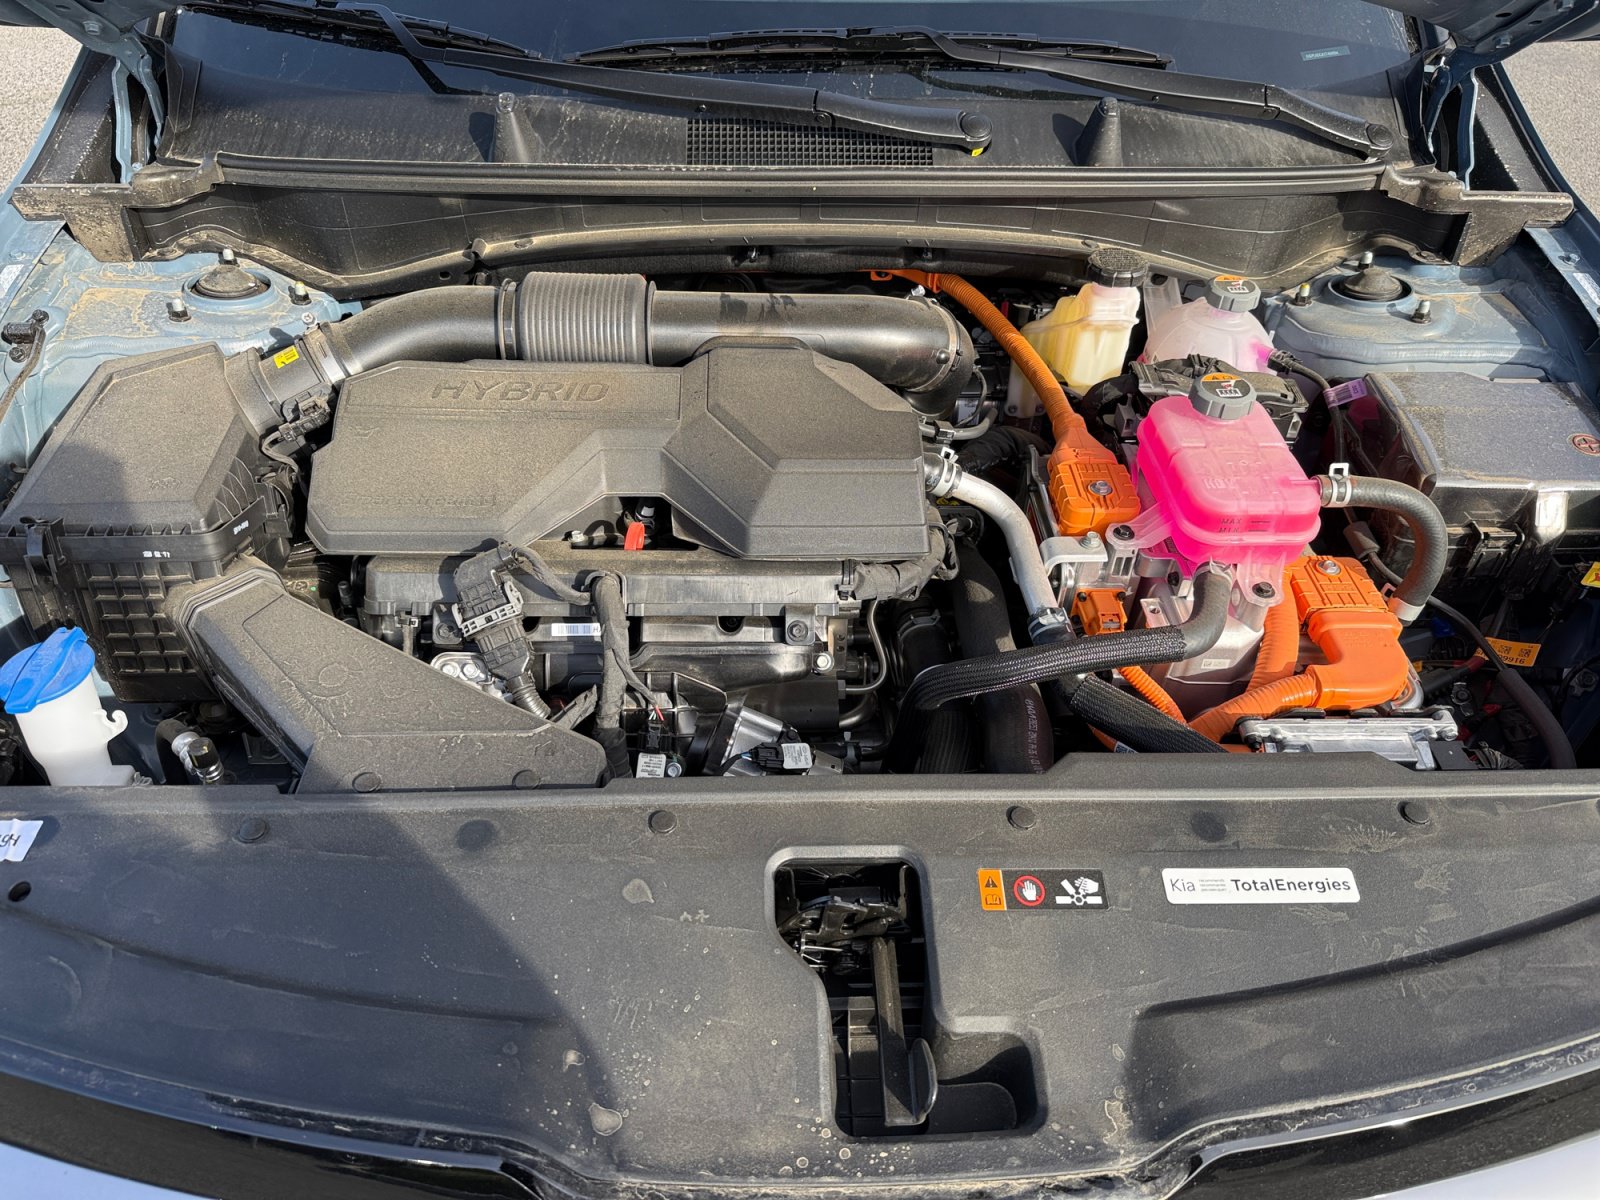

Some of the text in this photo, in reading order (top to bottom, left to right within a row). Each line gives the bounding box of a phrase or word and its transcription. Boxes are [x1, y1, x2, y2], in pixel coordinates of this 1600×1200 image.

[431, 380, 610, 401] HYBRID
[1169, 878, 1351, 893] Kia TotalEnergies
